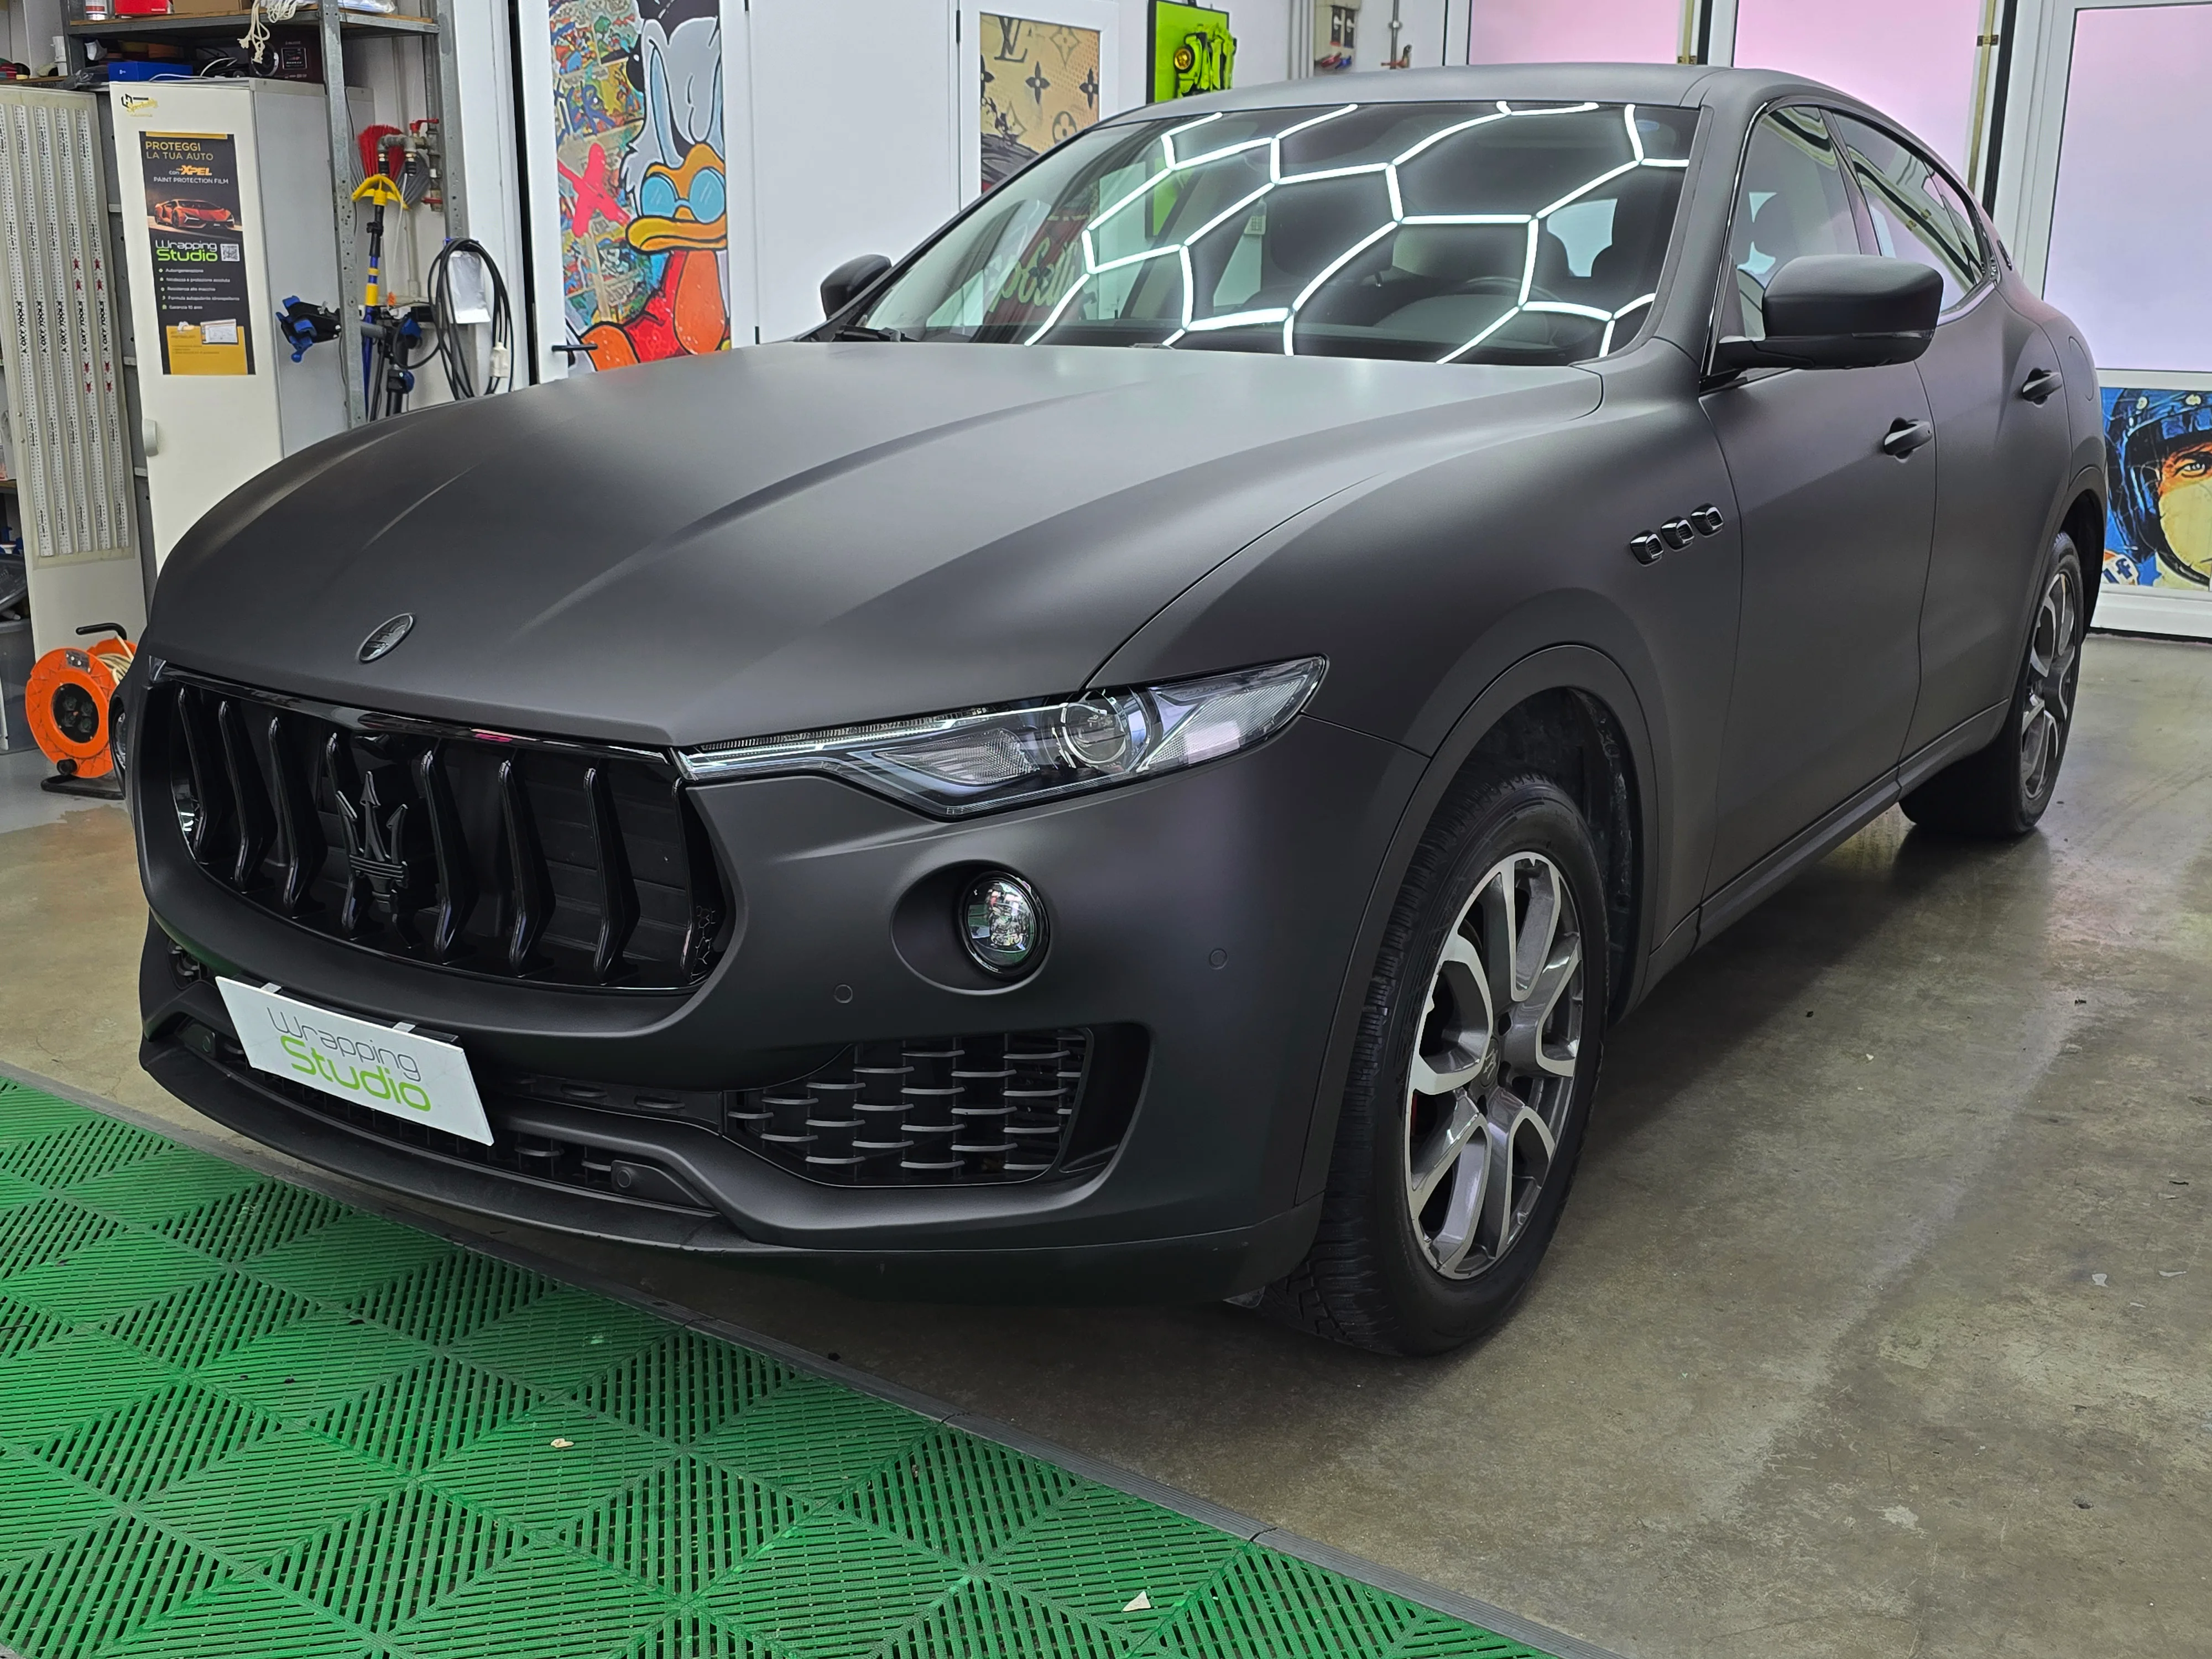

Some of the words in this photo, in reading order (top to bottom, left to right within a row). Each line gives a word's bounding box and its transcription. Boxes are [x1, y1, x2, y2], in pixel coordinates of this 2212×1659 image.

[145, 141, 201, 152] PROTEGGI
[186, 153, 213, 161] AUTO
[181, 165, 212, 176] XPEL
[155, 239, 217, 252] Wrapping
[156, 249, 218, 262] Studio
[267, 1007, 421, 1082] Wrapping
[280, 1035, 431, 1112] Studio
